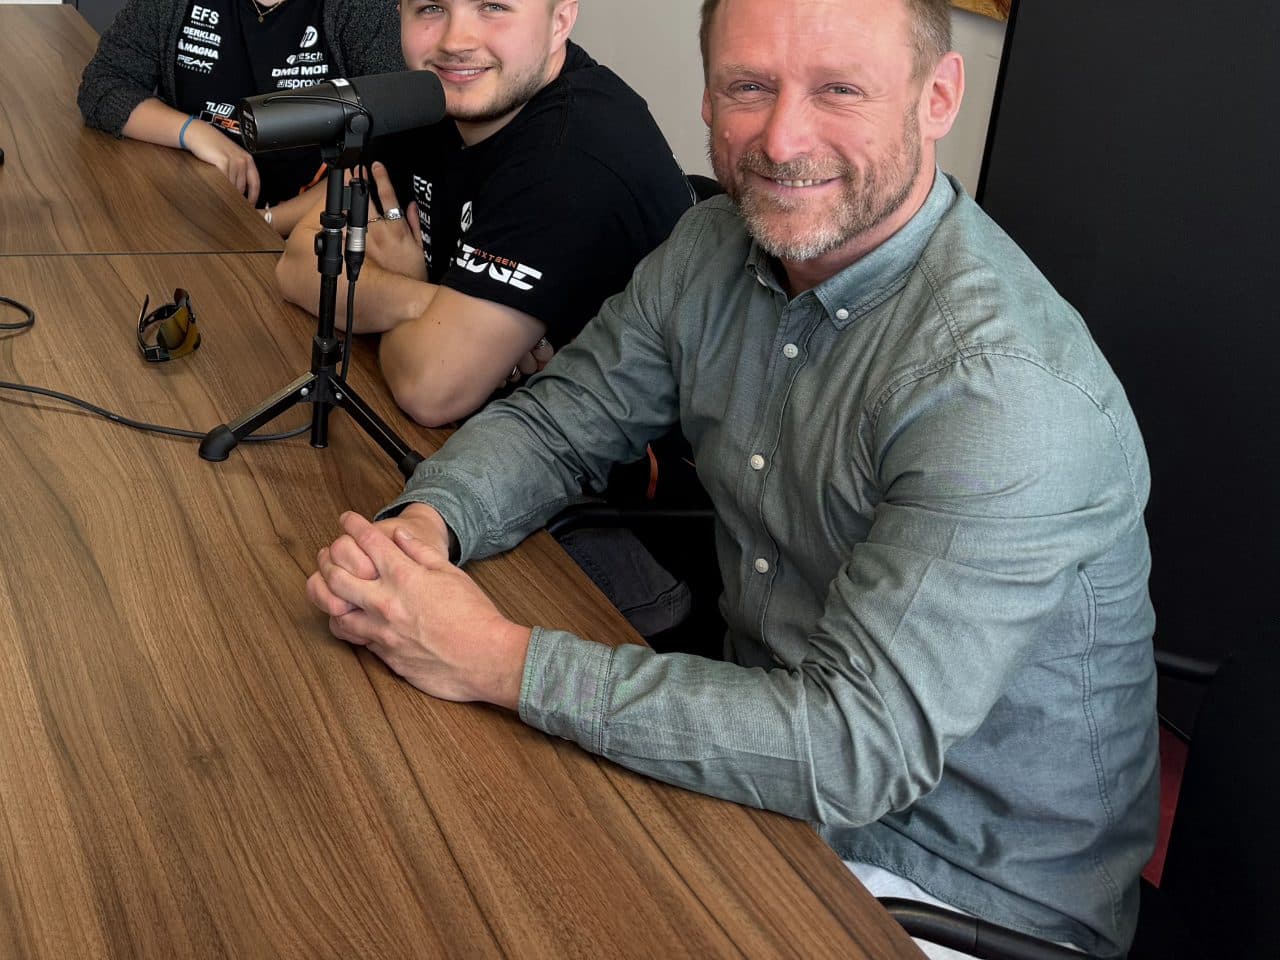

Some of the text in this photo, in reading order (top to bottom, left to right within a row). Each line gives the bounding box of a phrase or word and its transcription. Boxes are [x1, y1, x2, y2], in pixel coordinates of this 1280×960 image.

[190, 4, 220, 25] EFS
[184, 42, 219, 60] MAGNA
[177, 54, 214, 70] PEAK
[271, 64, 329, 77] DMG MOR
